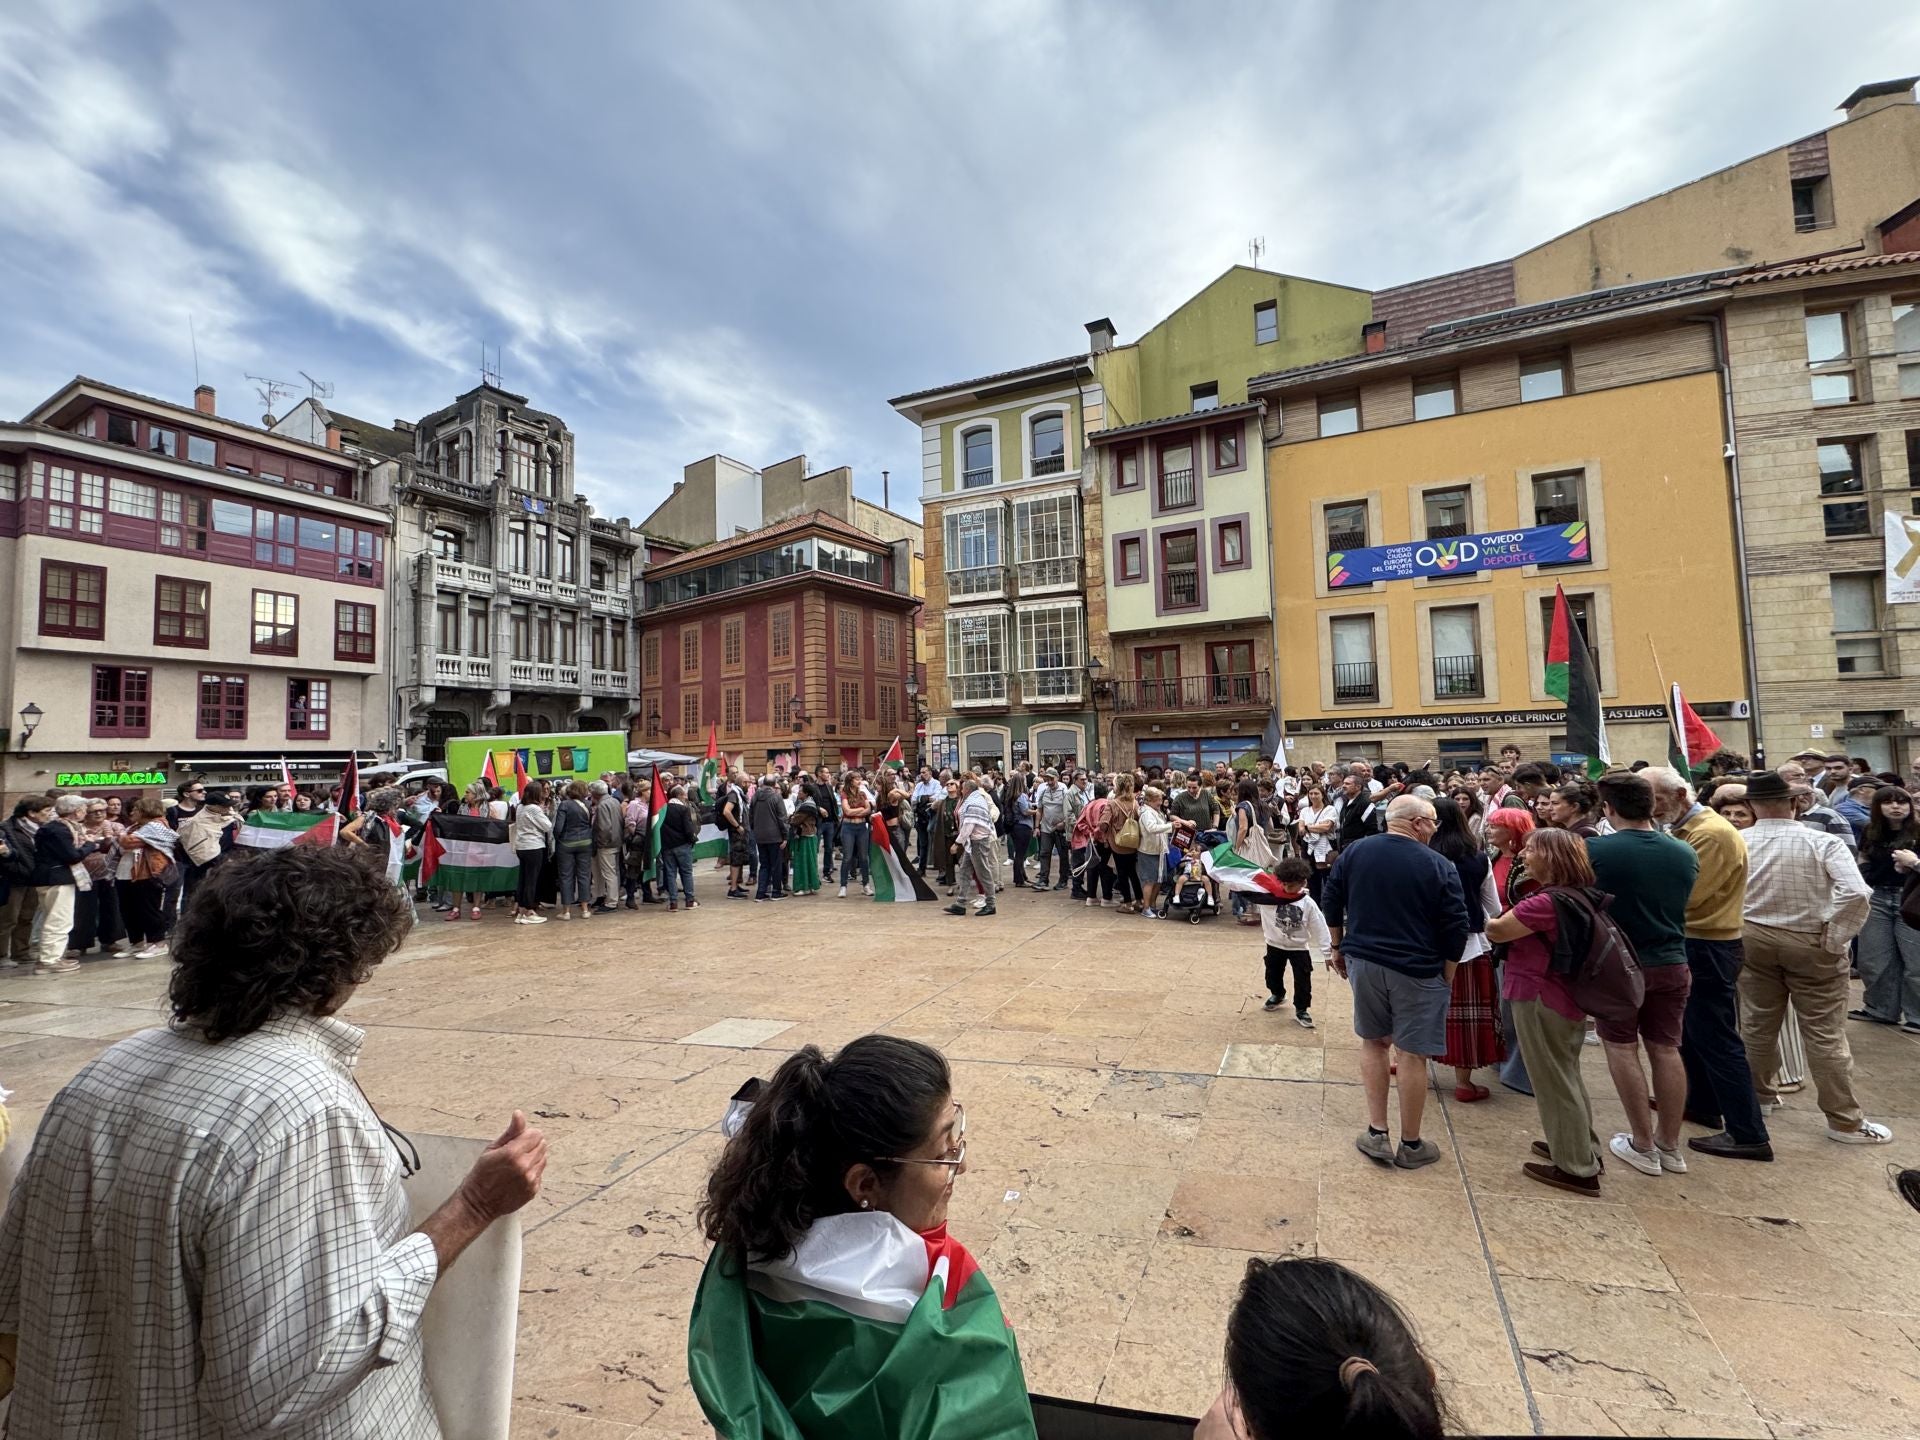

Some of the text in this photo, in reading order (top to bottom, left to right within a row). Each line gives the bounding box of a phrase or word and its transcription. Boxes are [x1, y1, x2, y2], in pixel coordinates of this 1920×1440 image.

[1481, 533, 1523, 545] OVIEDO
[1386, 547, 1412, 555] OVIEDO
[1482, 544, 1522, 555] VIVE EL
[1387, 552, 1412, 560] CIUDAD
[1483, 553, 1535, 565] DEPORTE
[1383, 558, 1412, 566] EUROPEA
[1385, 563, 1412, 571] DEPORTE
[1333, 720, 1369, 729] CENTRO
[1370, 719, 1383, 728] DE
[1504, 713, 1524, 723] DEL
[1526, 712, 1567, 722] PRINCIP
[1609, 708, 1663, 719] ASTURIAS
[57, 772, 167, 786] FARMACIA
[244, 774, 251, 782] 4
[255, 773, 299, 782] CALLS
